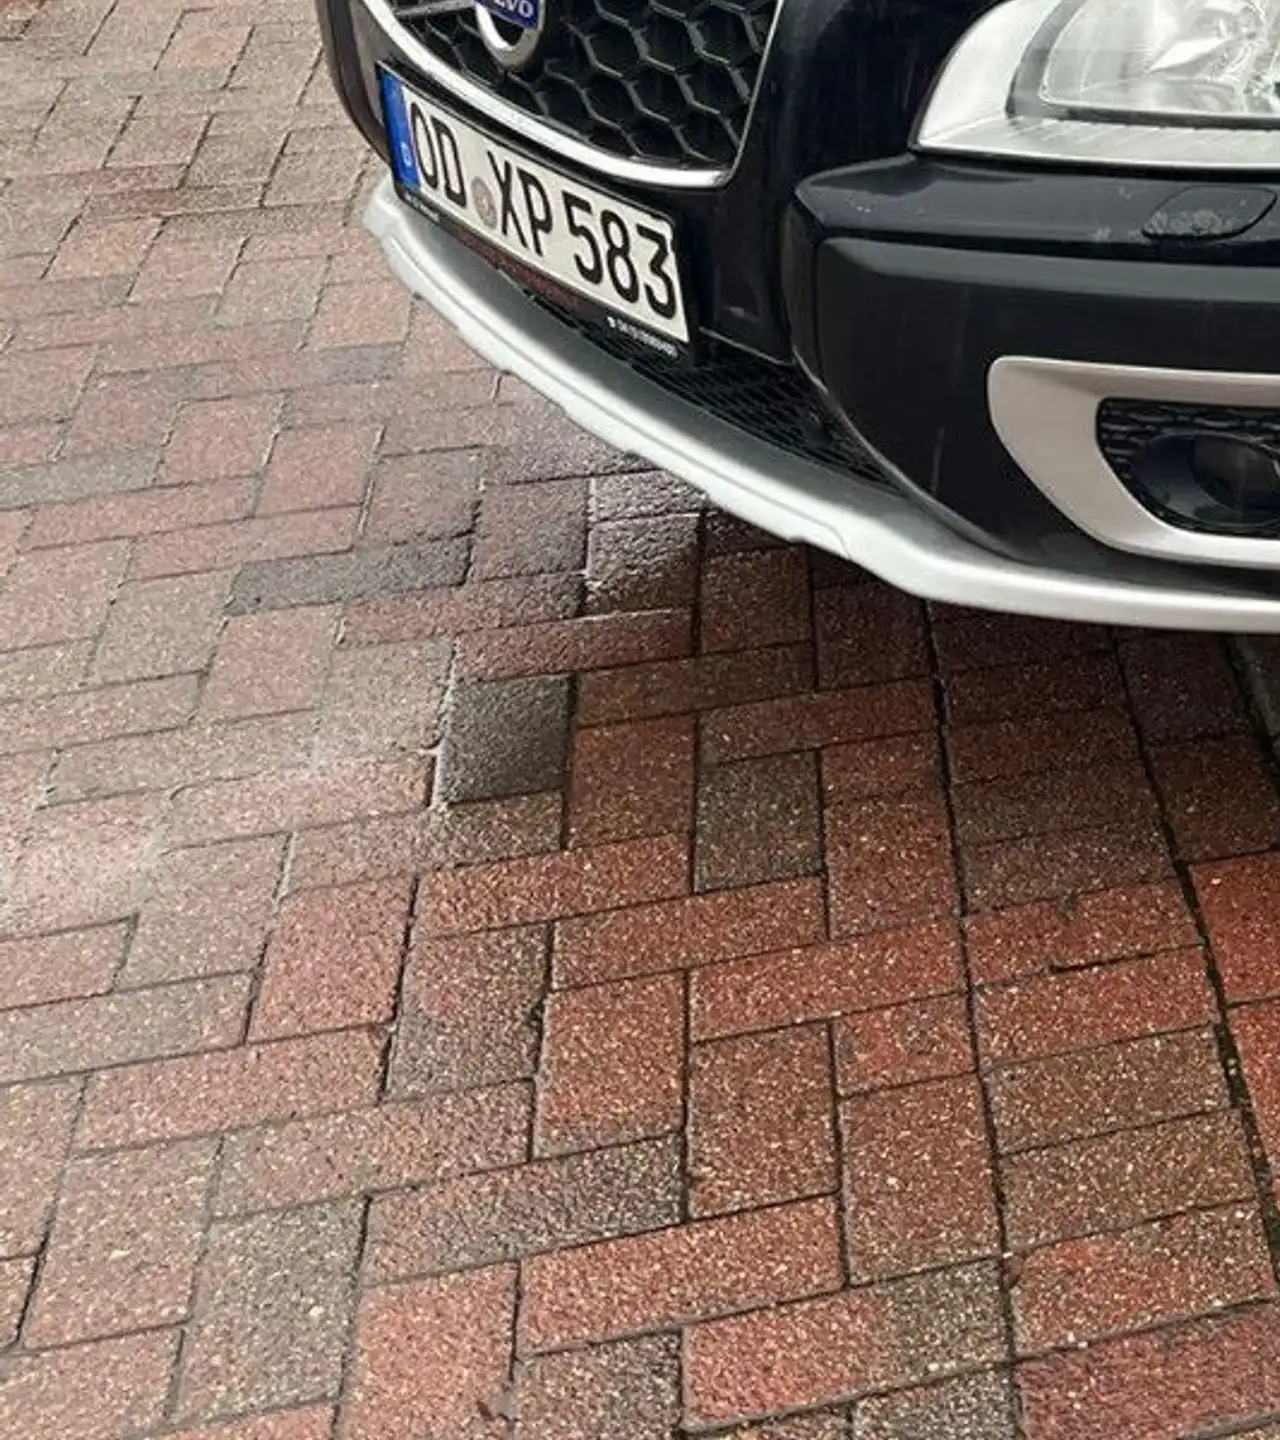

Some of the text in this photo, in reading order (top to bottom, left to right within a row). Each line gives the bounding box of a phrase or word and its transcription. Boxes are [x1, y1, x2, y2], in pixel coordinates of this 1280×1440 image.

[410, 101, 467, 209] OD
[487, 149, 553, 257] XP
[563, 203, 677, 321] 583
